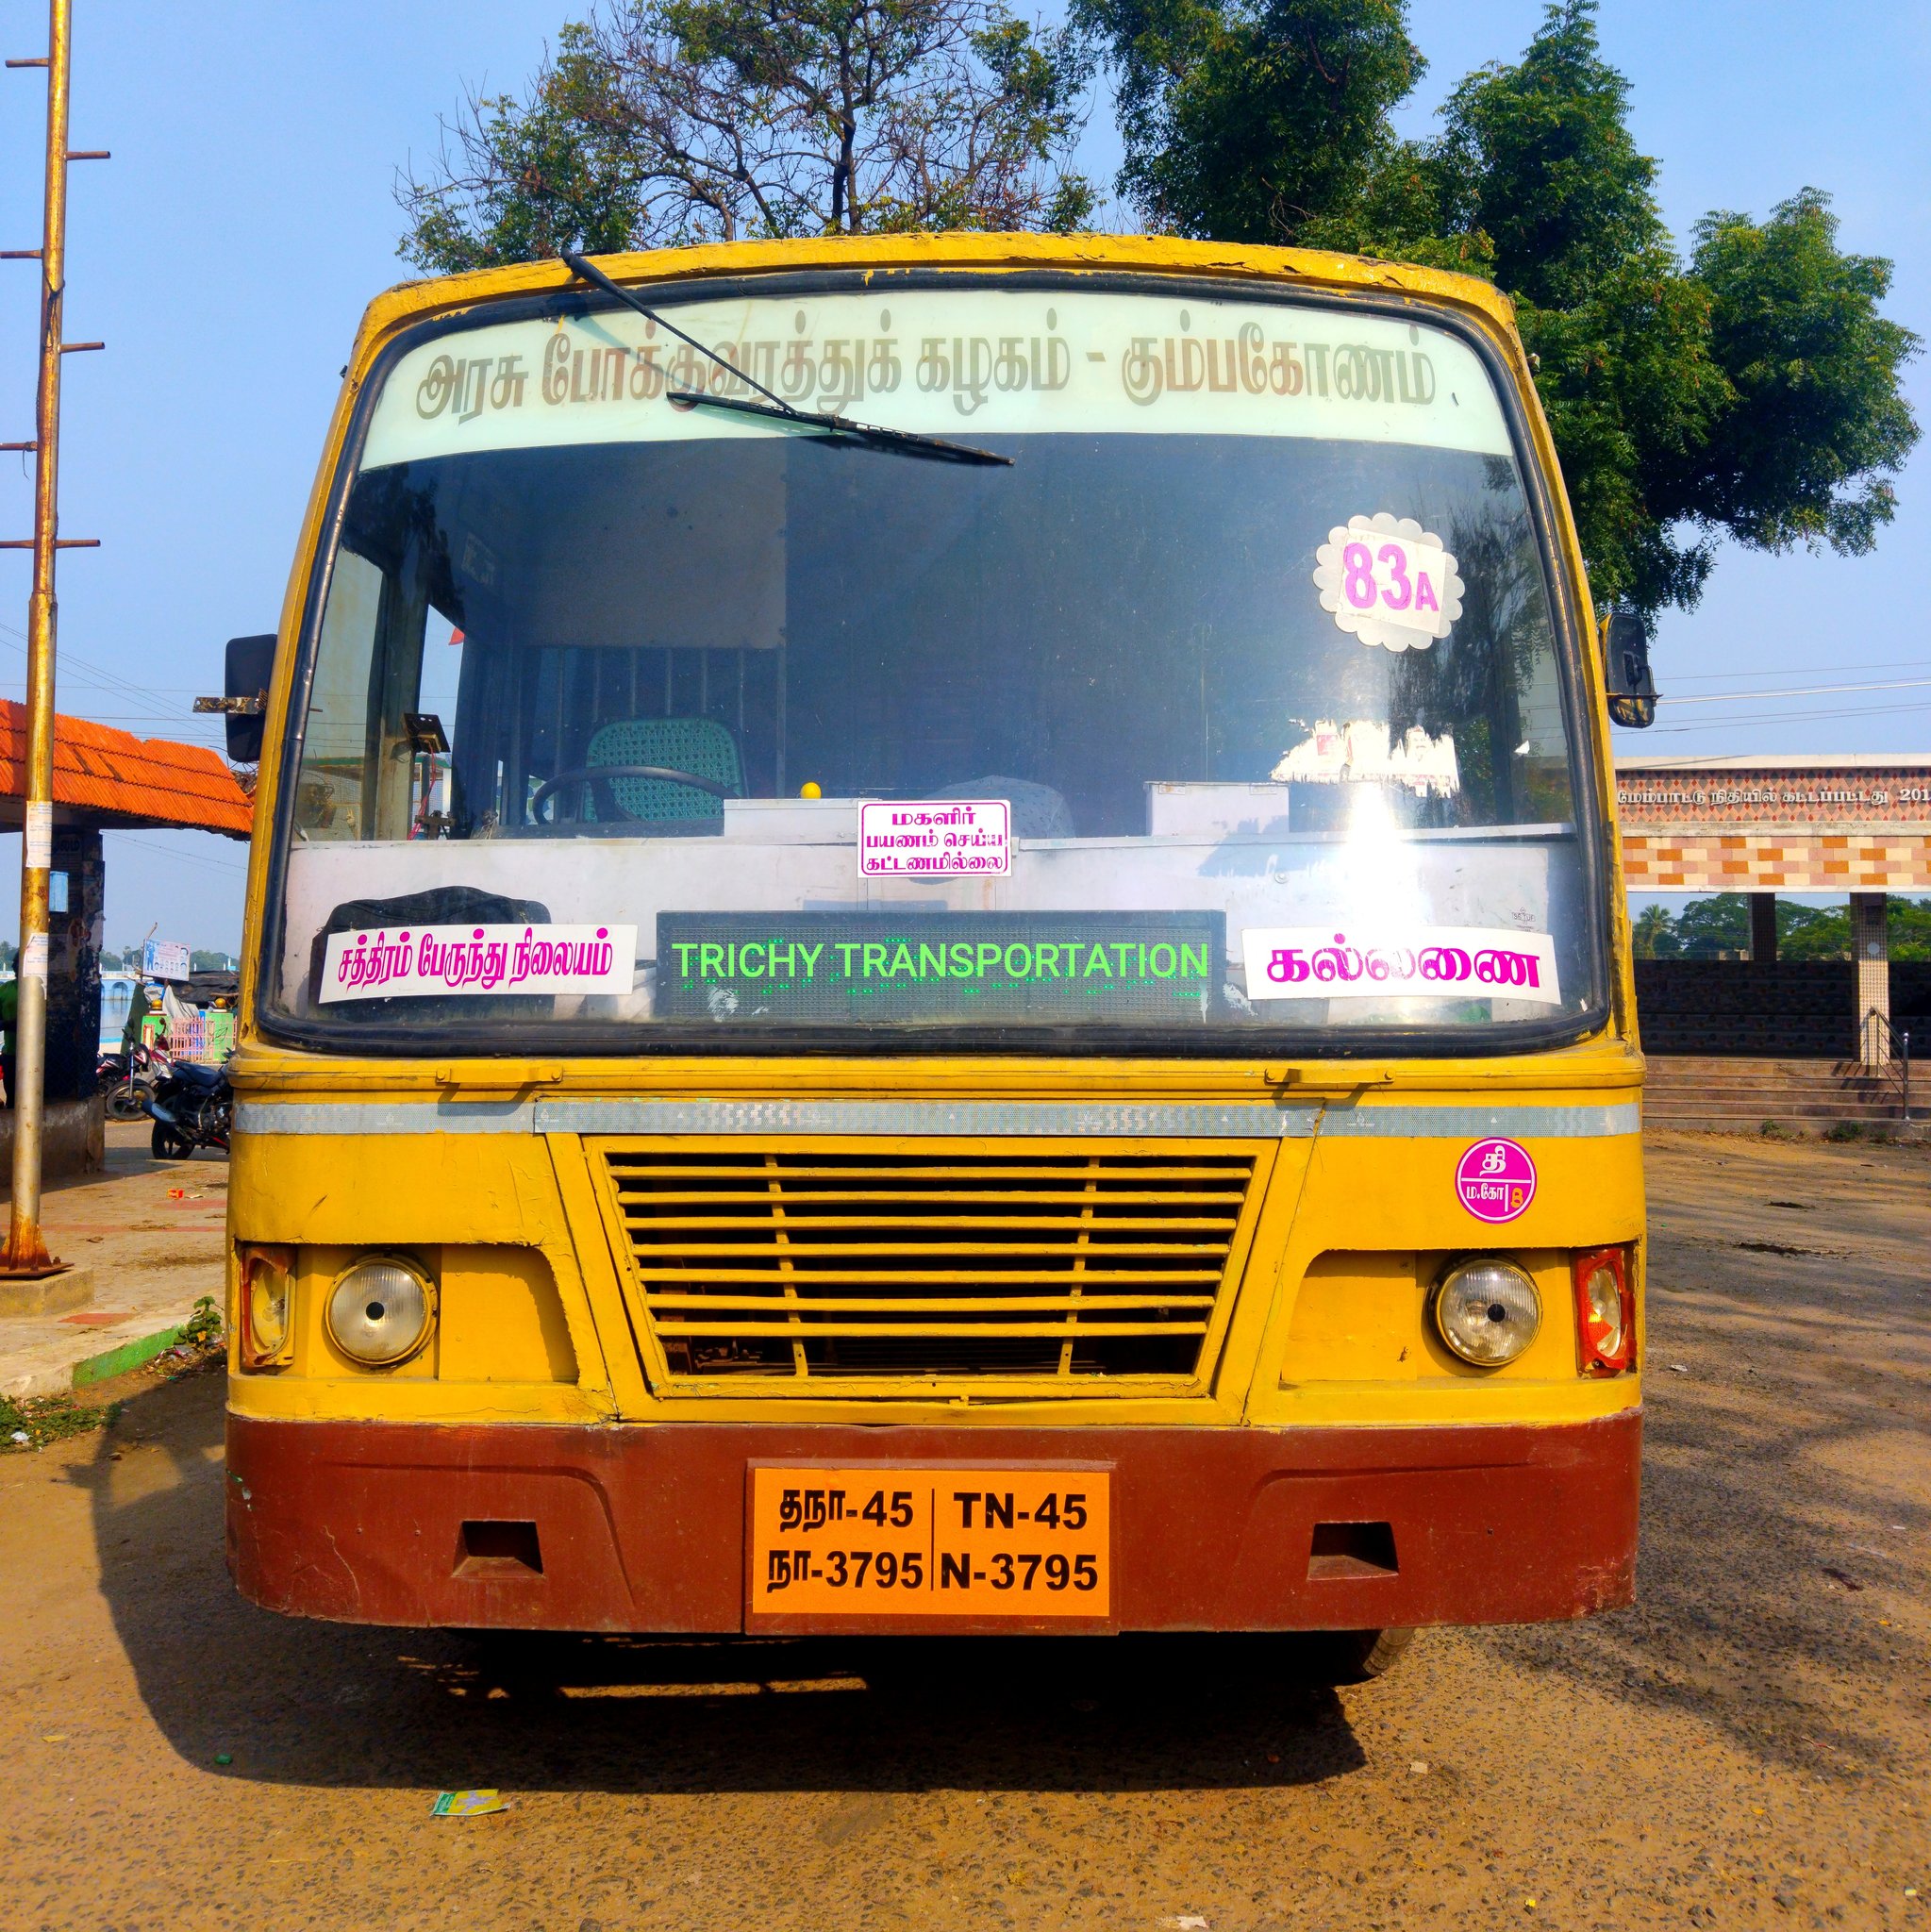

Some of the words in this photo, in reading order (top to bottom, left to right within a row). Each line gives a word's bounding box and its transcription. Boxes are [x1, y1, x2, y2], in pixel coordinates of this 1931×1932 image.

[416, 353, 528, 425] அரசு
[915, 308, 1071, 417] கழகம்
[1122, 308, 1436, 406] கும்பகோணம்
[1343, 542, 1440, 612] 83A
[891, 806, 976, 825] மகளிர்
[1709, 787, 1777, 806] நிதியில்
[866, 828, 939, 848] பயணம்
[943, 827, 1003, 847] செய்ய
[866, 851, 1003, 871] கட்டணமில்லை
[338, 931, 413, 991] சத்திரம்
[417, 927, 508, 990] பேருந்து
[508, 926, 613, 990] நிலையம்
[1267, 932, 1540, 989] கல்லணை
[1479, 1144, 1507, 1177] தி
[953, 1491, 1089, 1531] TN-45
[766, 1550, 924, 1593] நா-3795
[941, 1552, 1099, 1592] N-3795
